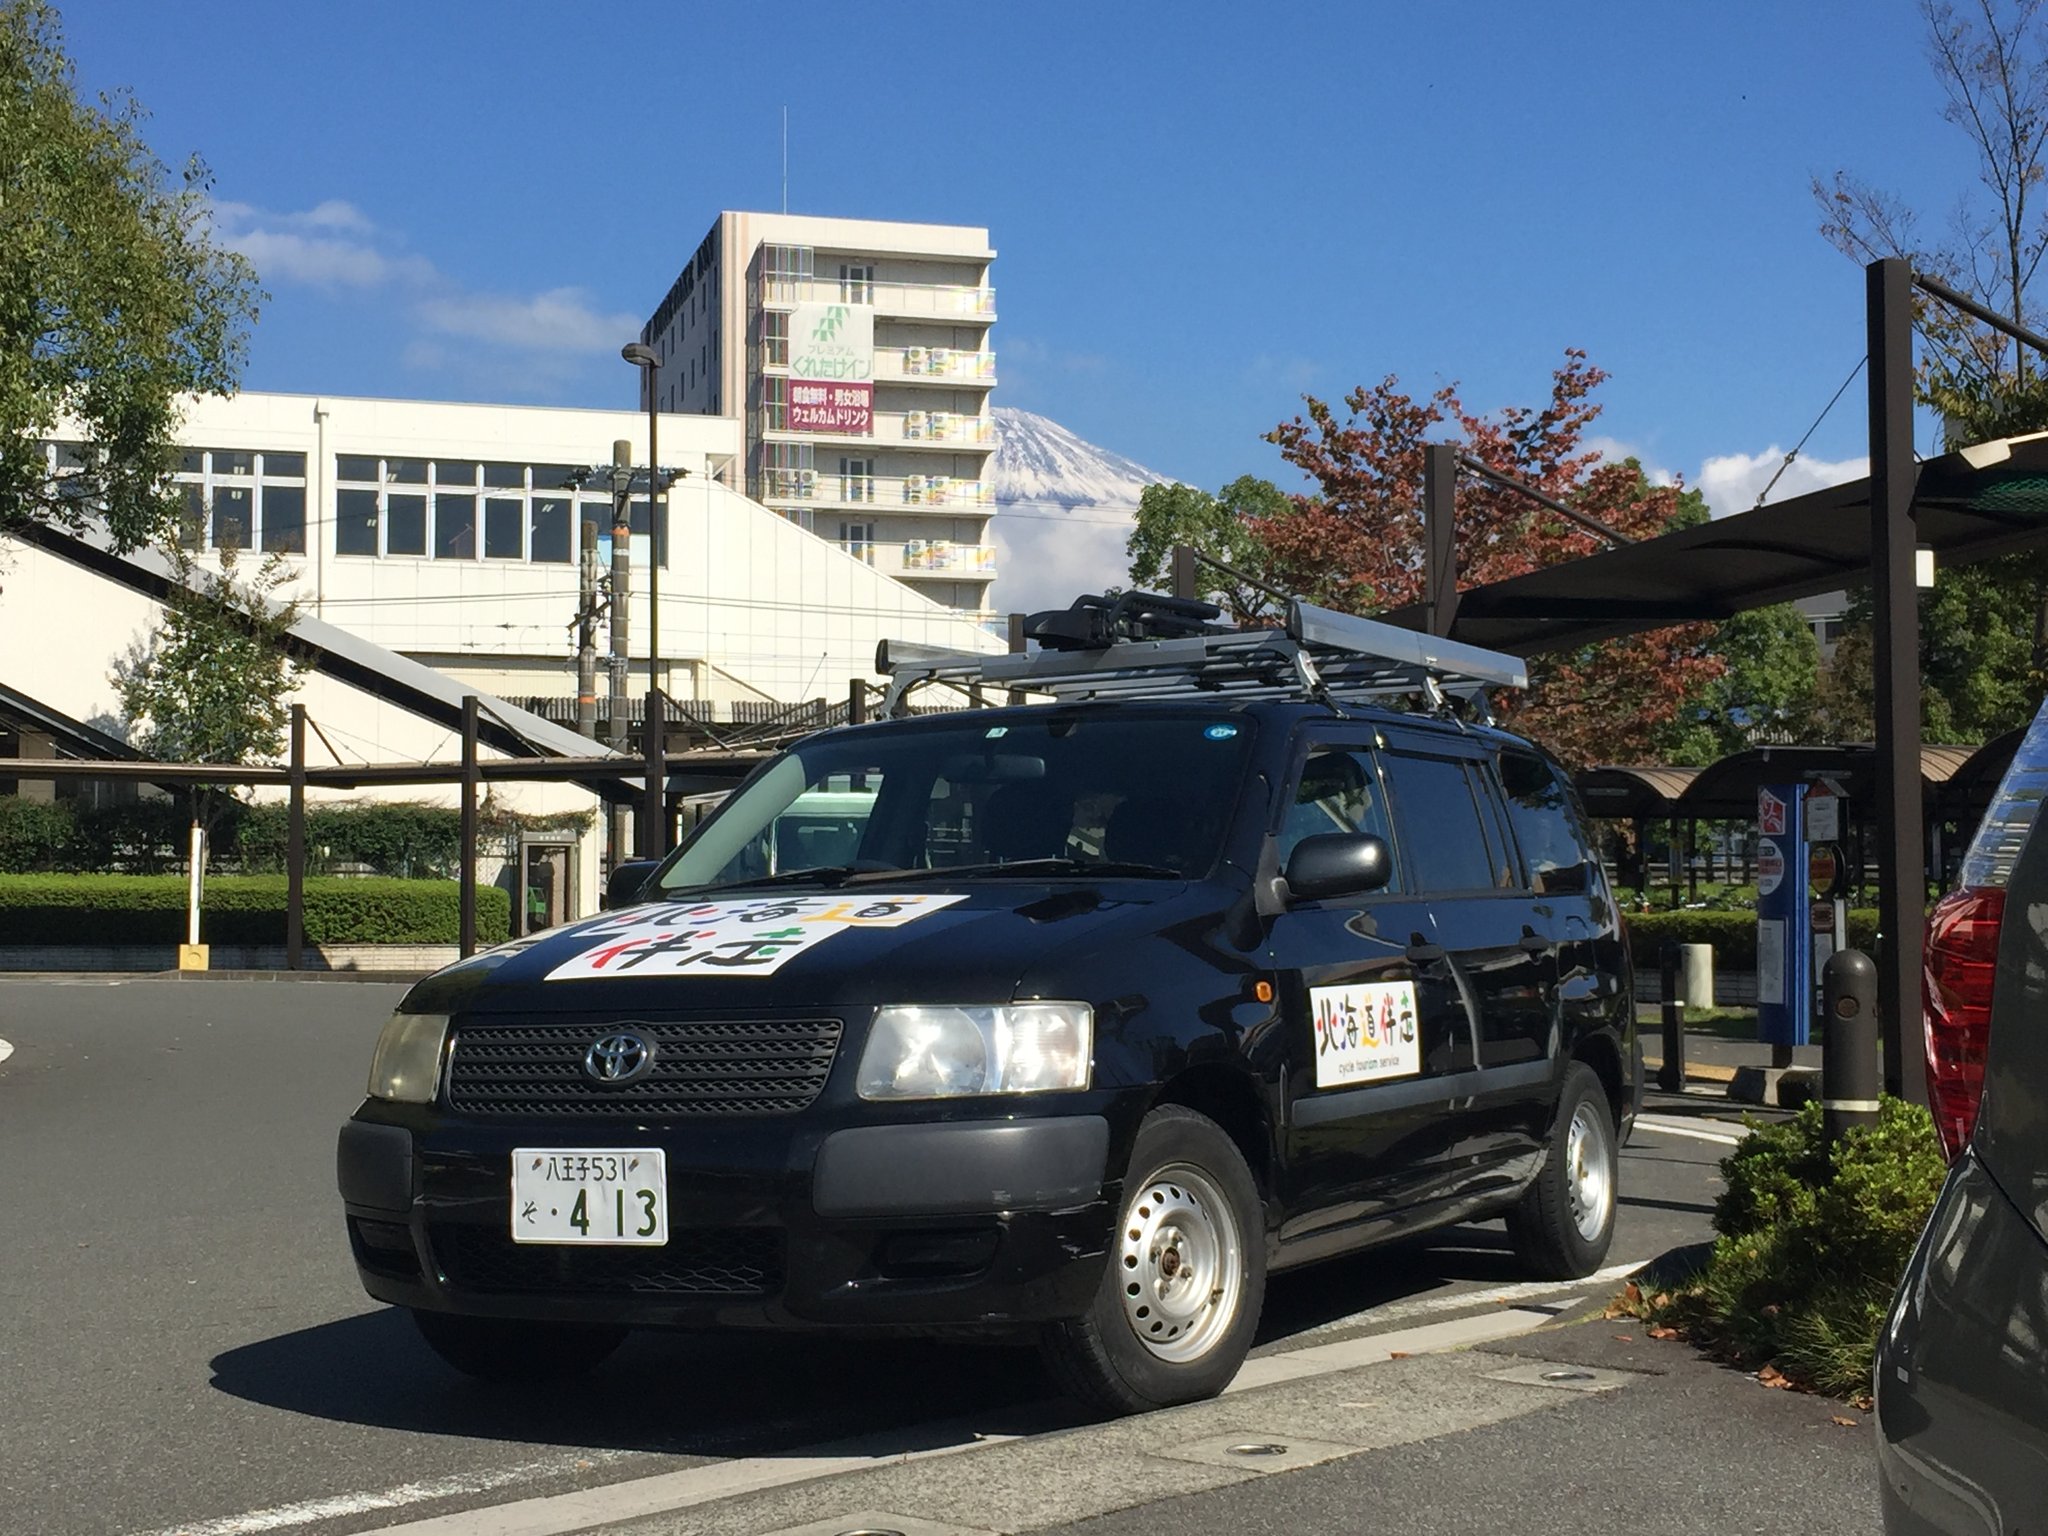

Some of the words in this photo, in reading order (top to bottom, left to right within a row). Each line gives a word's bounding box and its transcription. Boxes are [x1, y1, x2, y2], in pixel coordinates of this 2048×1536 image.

[808, 344, 855, 356] プレミアム
[792, 355, 872, 380] くれたけイン
[792, 406, 869, 426] ウェルカムドリンク
[546, 1157, 626, 1181] 八王子531
